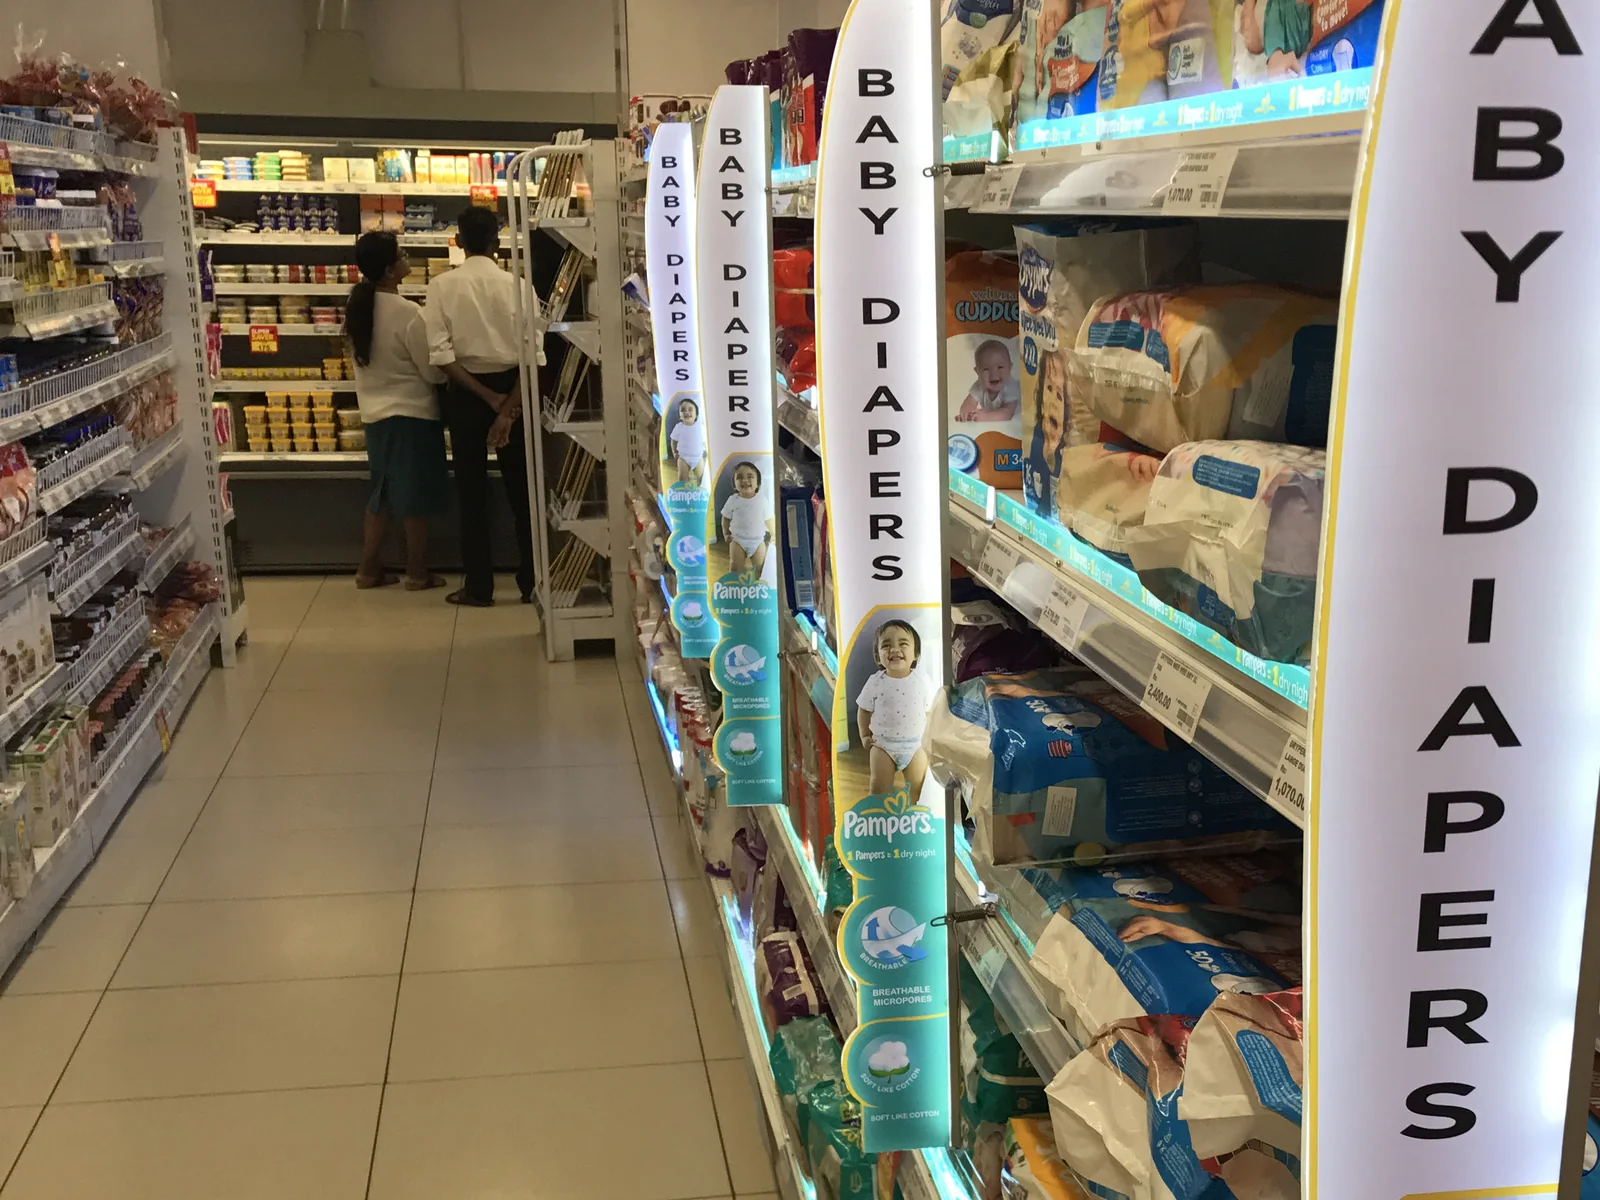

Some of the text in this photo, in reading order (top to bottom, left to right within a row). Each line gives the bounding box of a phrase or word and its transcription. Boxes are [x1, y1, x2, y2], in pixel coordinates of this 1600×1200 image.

[661, 156, 689, 381] BABY DIAPERS
[718, 128, 750, 437] BABY DIAPERS
[855, 69, 904, 580] BABY DIAPERS
[997, 454, 1008, 466] M
[667, 488, 709, 504] Pampers
[713, 582, 769, 604] Pampers
[1272, 665, 1279, 686] 1
[1279, 673, 1291, 696] dry
[1147, 683, 1171, 710] 2,400.00
[1400, 466, 1538, 1139] DIAPERS
[843, 811, 931, 843] Pampers
[847, 851, 853, 860] 1
[855, 850, 885, 862] Pampers
[893, 849, 900, 858] 1
[900, 850, 913, 859] dry
[915, 848, 936, 859] night
[860, 952, 908, 970] BREATHABLE
[872, 985, 931, 996] BREATHABLE
[873, 995, 932, 1007] MICROPORES
[860, 1073, 876, 1092] SOFT
[895, 1068, 921, 1091] COTTON
[870, 1114, 889, 1122] SOFT
[909, 1110, 939, 1118] COTTON
